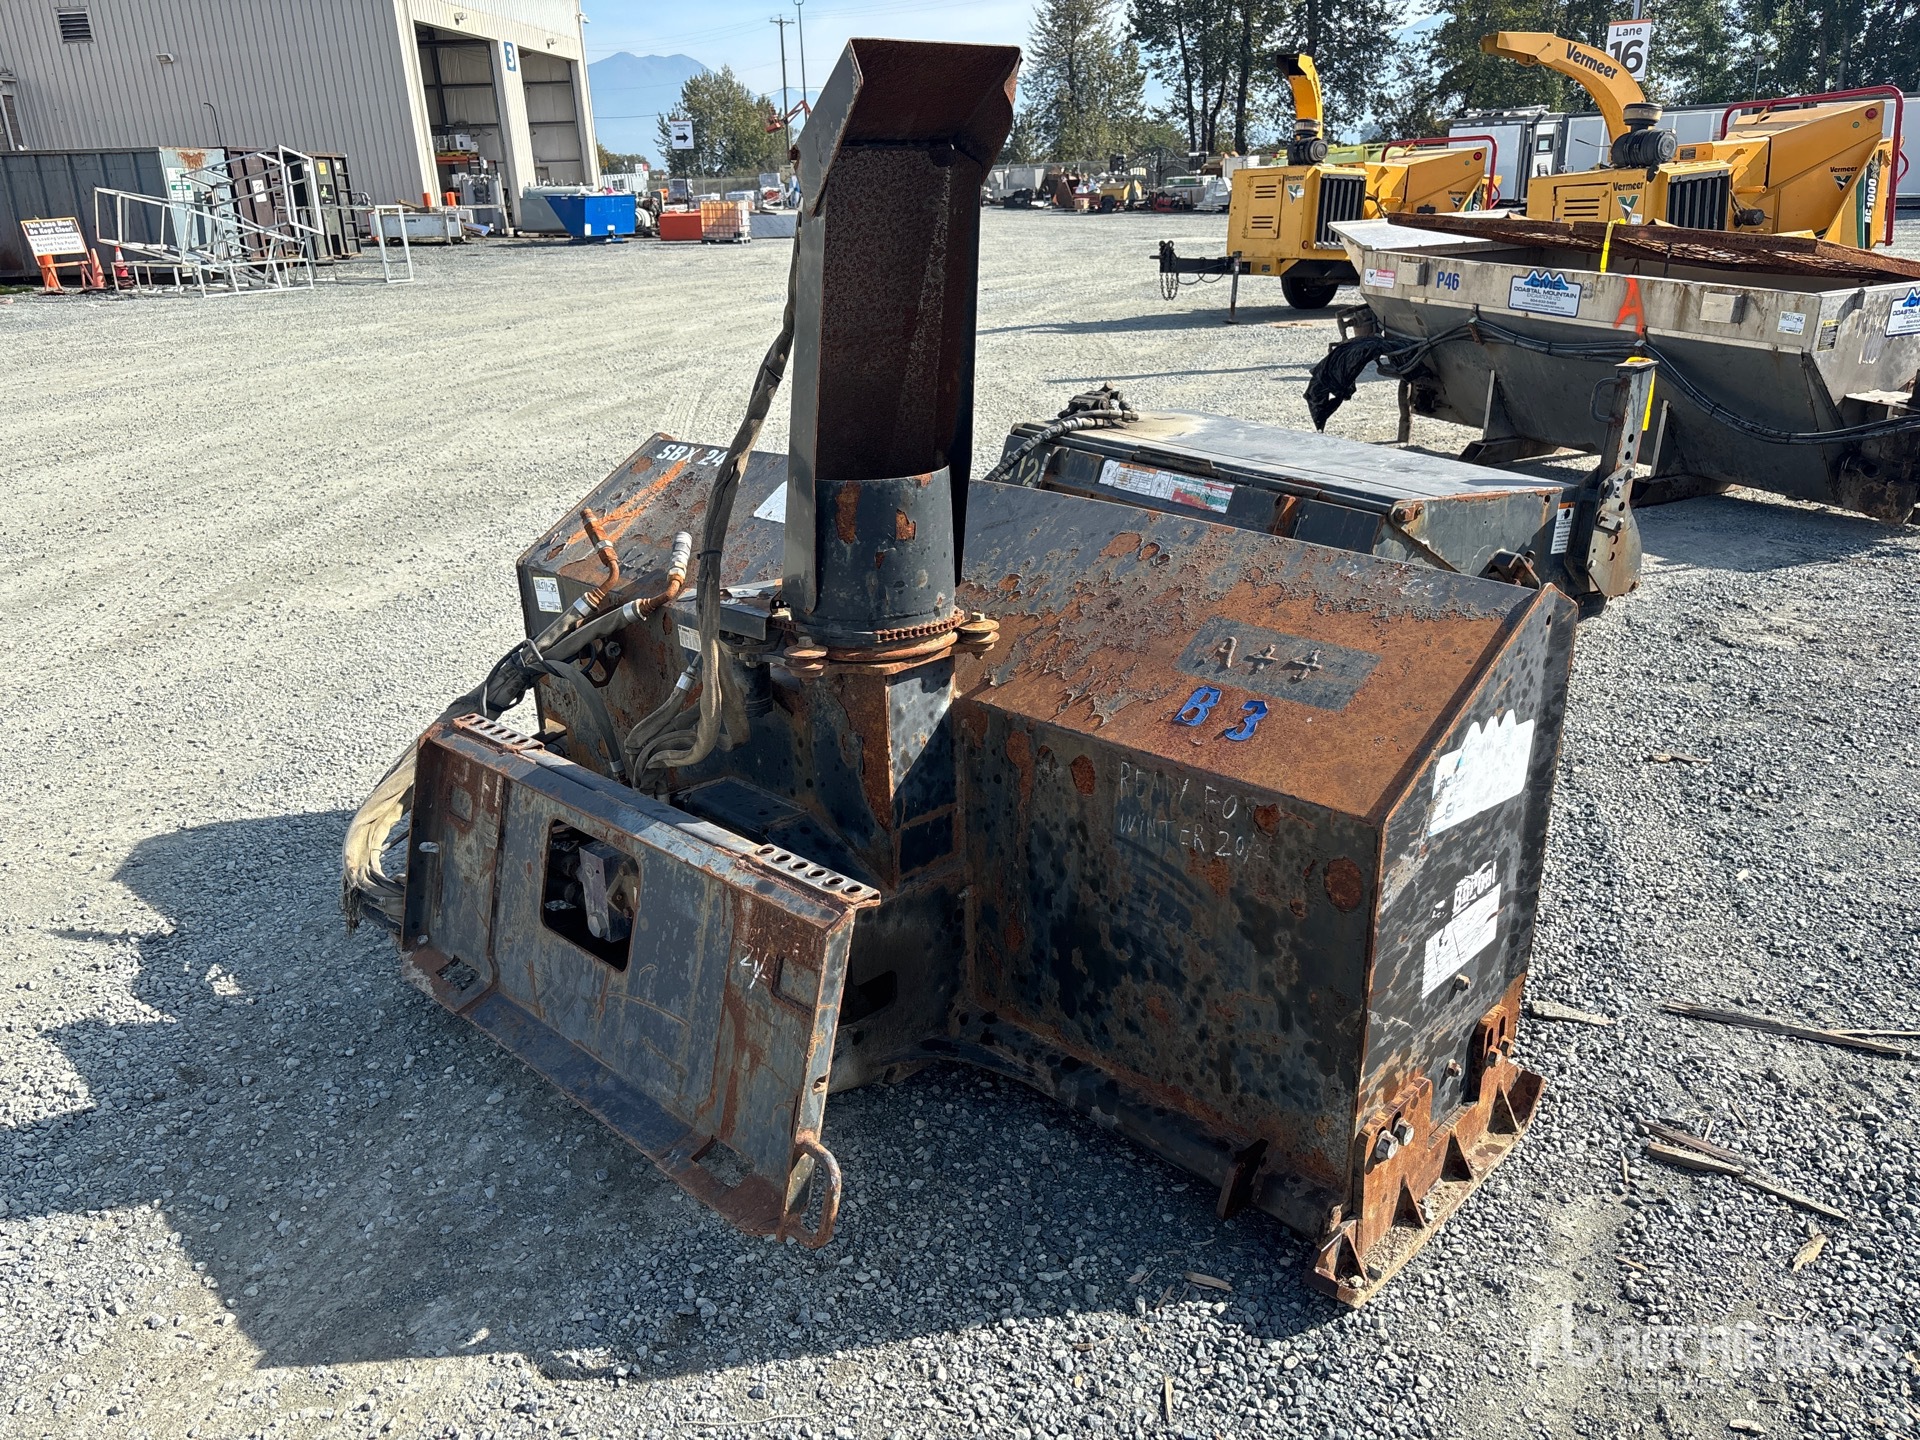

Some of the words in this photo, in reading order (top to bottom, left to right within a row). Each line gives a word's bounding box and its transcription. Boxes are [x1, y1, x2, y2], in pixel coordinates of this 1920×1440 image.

[1616, 27, 1643, 36] Lane
[506, 45, 515, 67] 3
[1566, 42, 1618, 80] Vermeer
[1609, 39, 1644, 74] 16
[1612, 181, 1644, 191] Vermeer
[39, 227, 55, 235] Kept
[1436, 271, 1460, 291] P46
[1530, 277, 1562, 291] CME
[1513, 286, 1542, 295] COASTAL
[1543, 289, 1577, 299] MOUNTAIN
[1612, 277, 1645, 336] A
[656, 444, 703, 463] SBX
